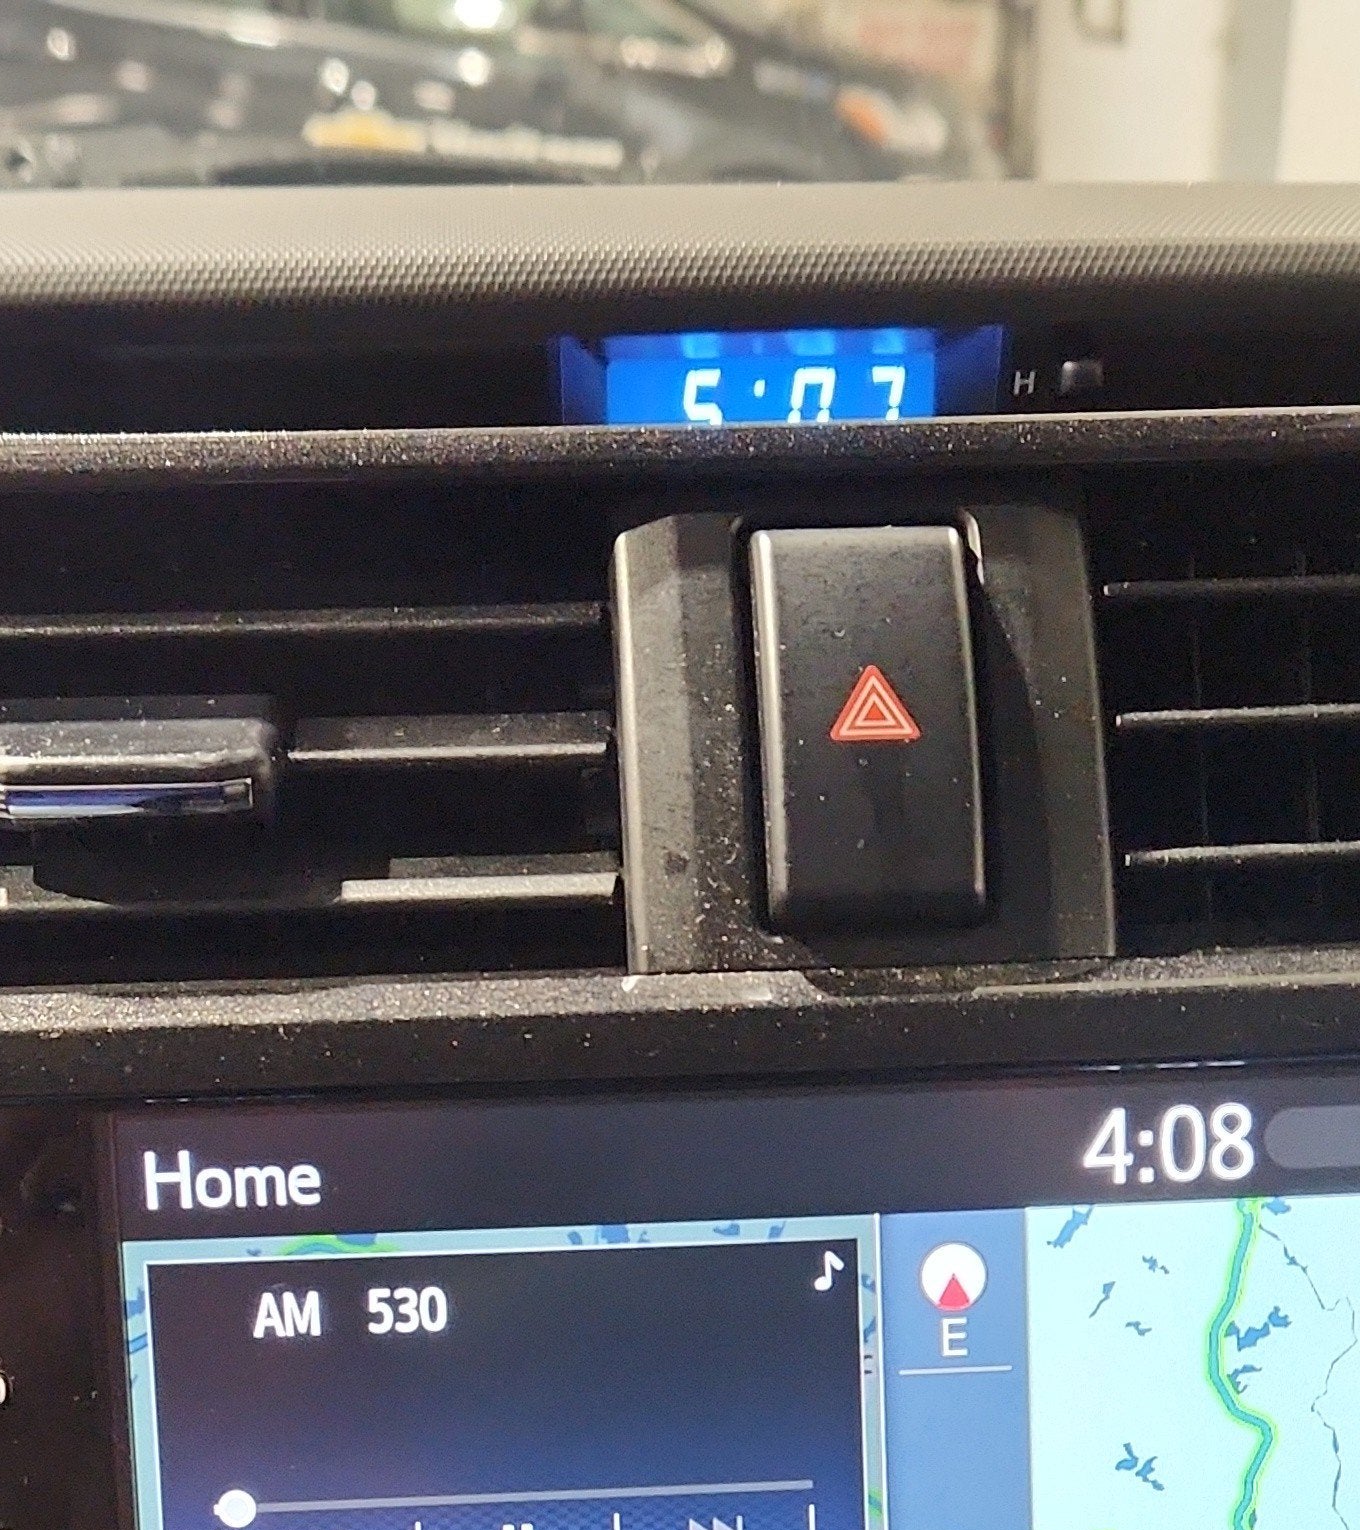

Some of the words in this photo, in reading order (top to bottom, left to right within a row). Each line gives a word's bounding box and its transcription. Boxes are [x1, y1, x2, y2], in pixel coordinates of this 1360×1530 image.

[1013, 370, 1036, 395] H
[1081, 1103, 1255, 1185] 4:08
[144, 1150, 322, 1211] Home
[252, 1290, 322, 1339] AM
[367, 1286, 447, 1334] 530
[940, 1317, 968, 1359] E
